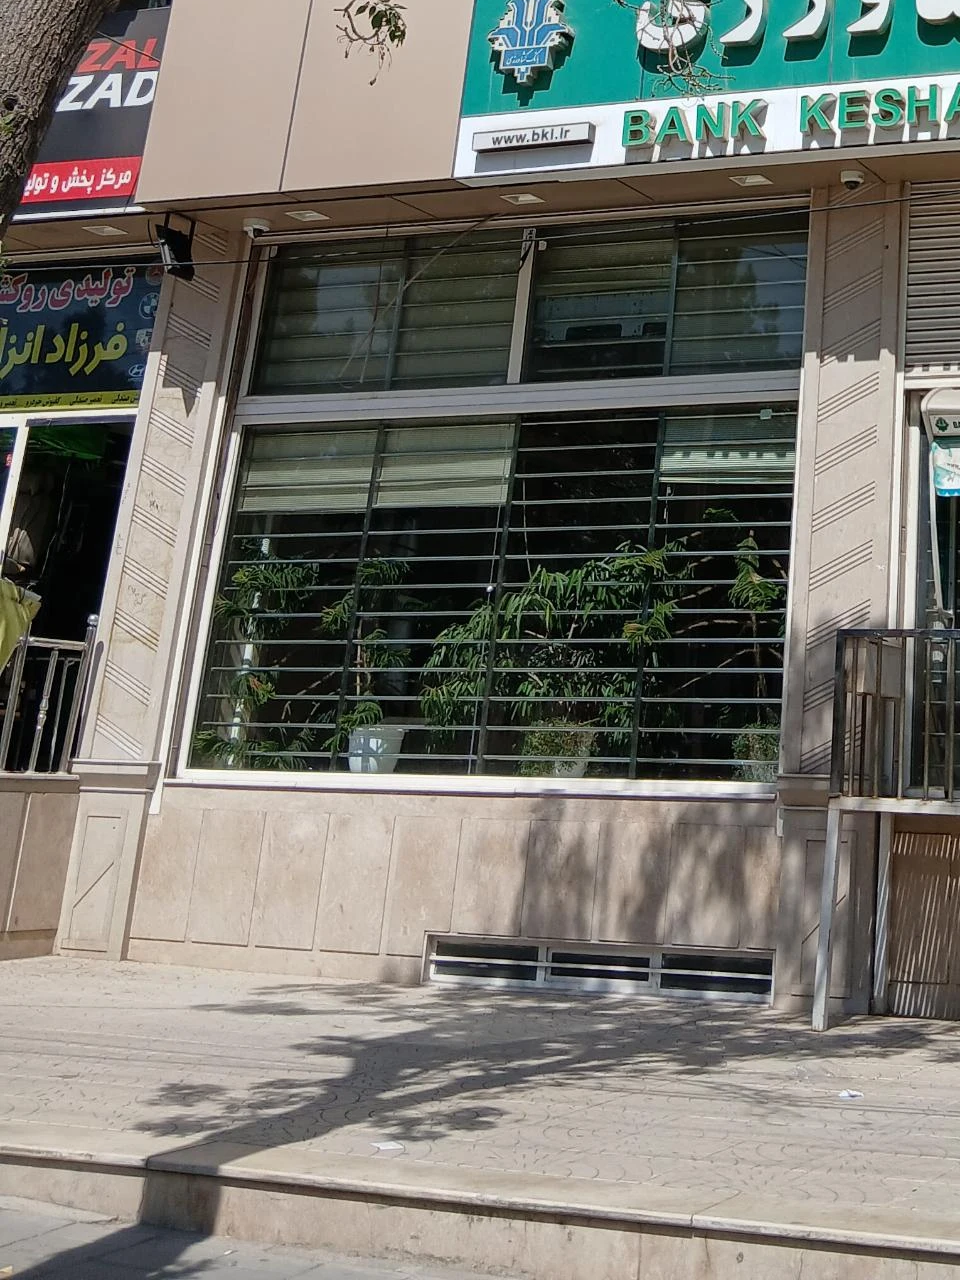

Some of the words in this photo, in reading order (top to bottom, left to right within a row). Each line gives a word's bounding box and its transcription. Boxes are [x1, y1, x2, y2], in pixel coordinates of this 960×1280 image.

[621, 98, 767, 147] BANK
[23, 172, 49, 197] تولی
[50, 175, 59, 193] و
[62, 166, 95, 195] پخش
[99, 168, 132, 191] مرکز
[49, 267, 137, 311] تولیدی
[45, 322, 128, 376] فرزاد
